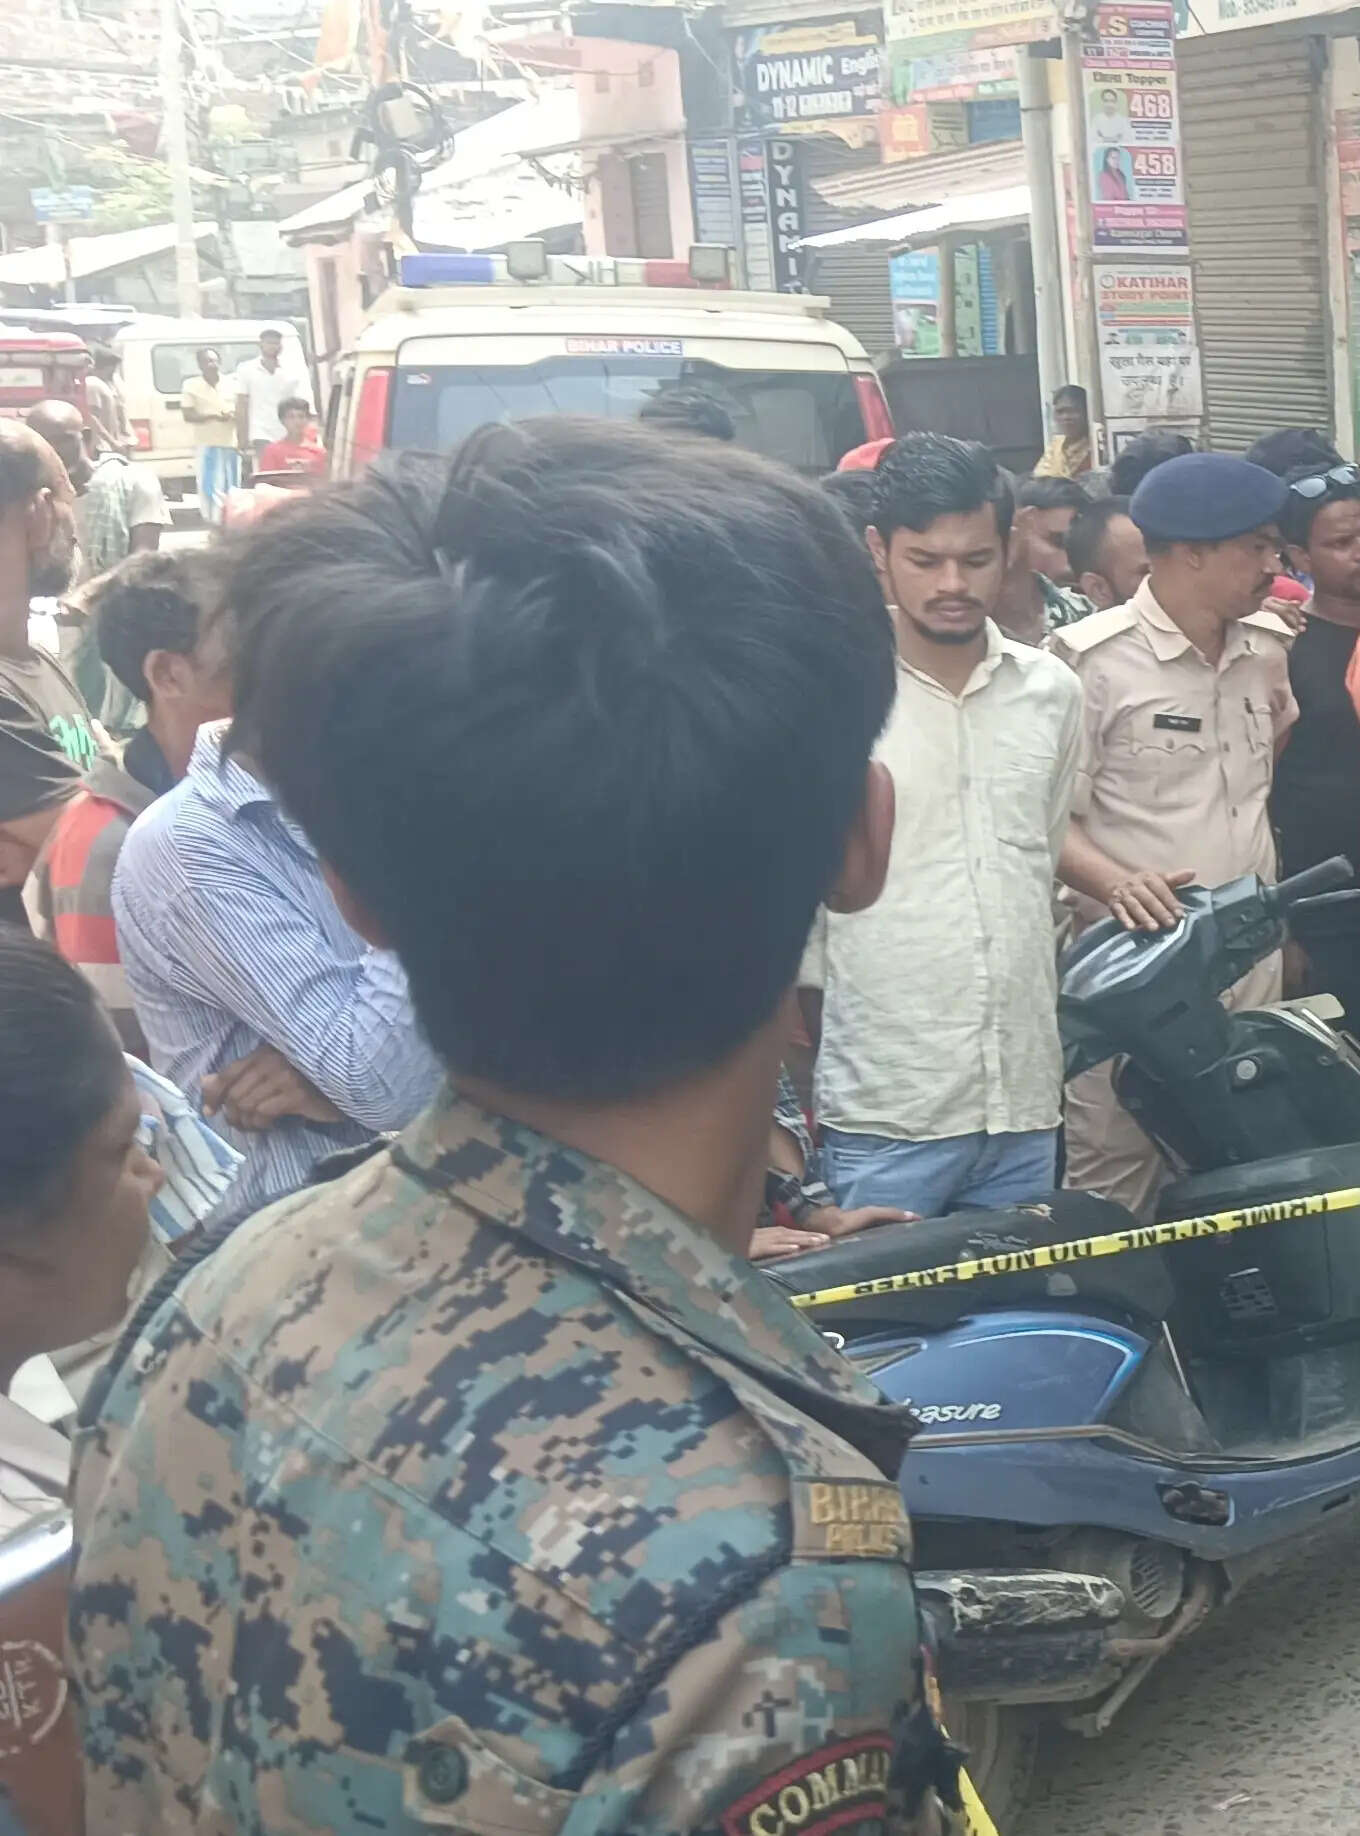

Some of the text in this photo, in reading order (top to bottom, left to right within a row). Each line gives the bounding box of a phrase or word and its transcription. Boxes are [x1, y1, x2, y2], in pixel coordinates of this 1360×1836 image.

[757, 55, 834, 91] DYNAMIC
[1130, 93, 1171, 118] 468
[1134, 153, 1176, 175] 458
[1116, 277, 1189, 289] KATIHAR
[1151, 291, 1189, 299] POINT
[567, 339, 681, 355] BIHAR POLICE
